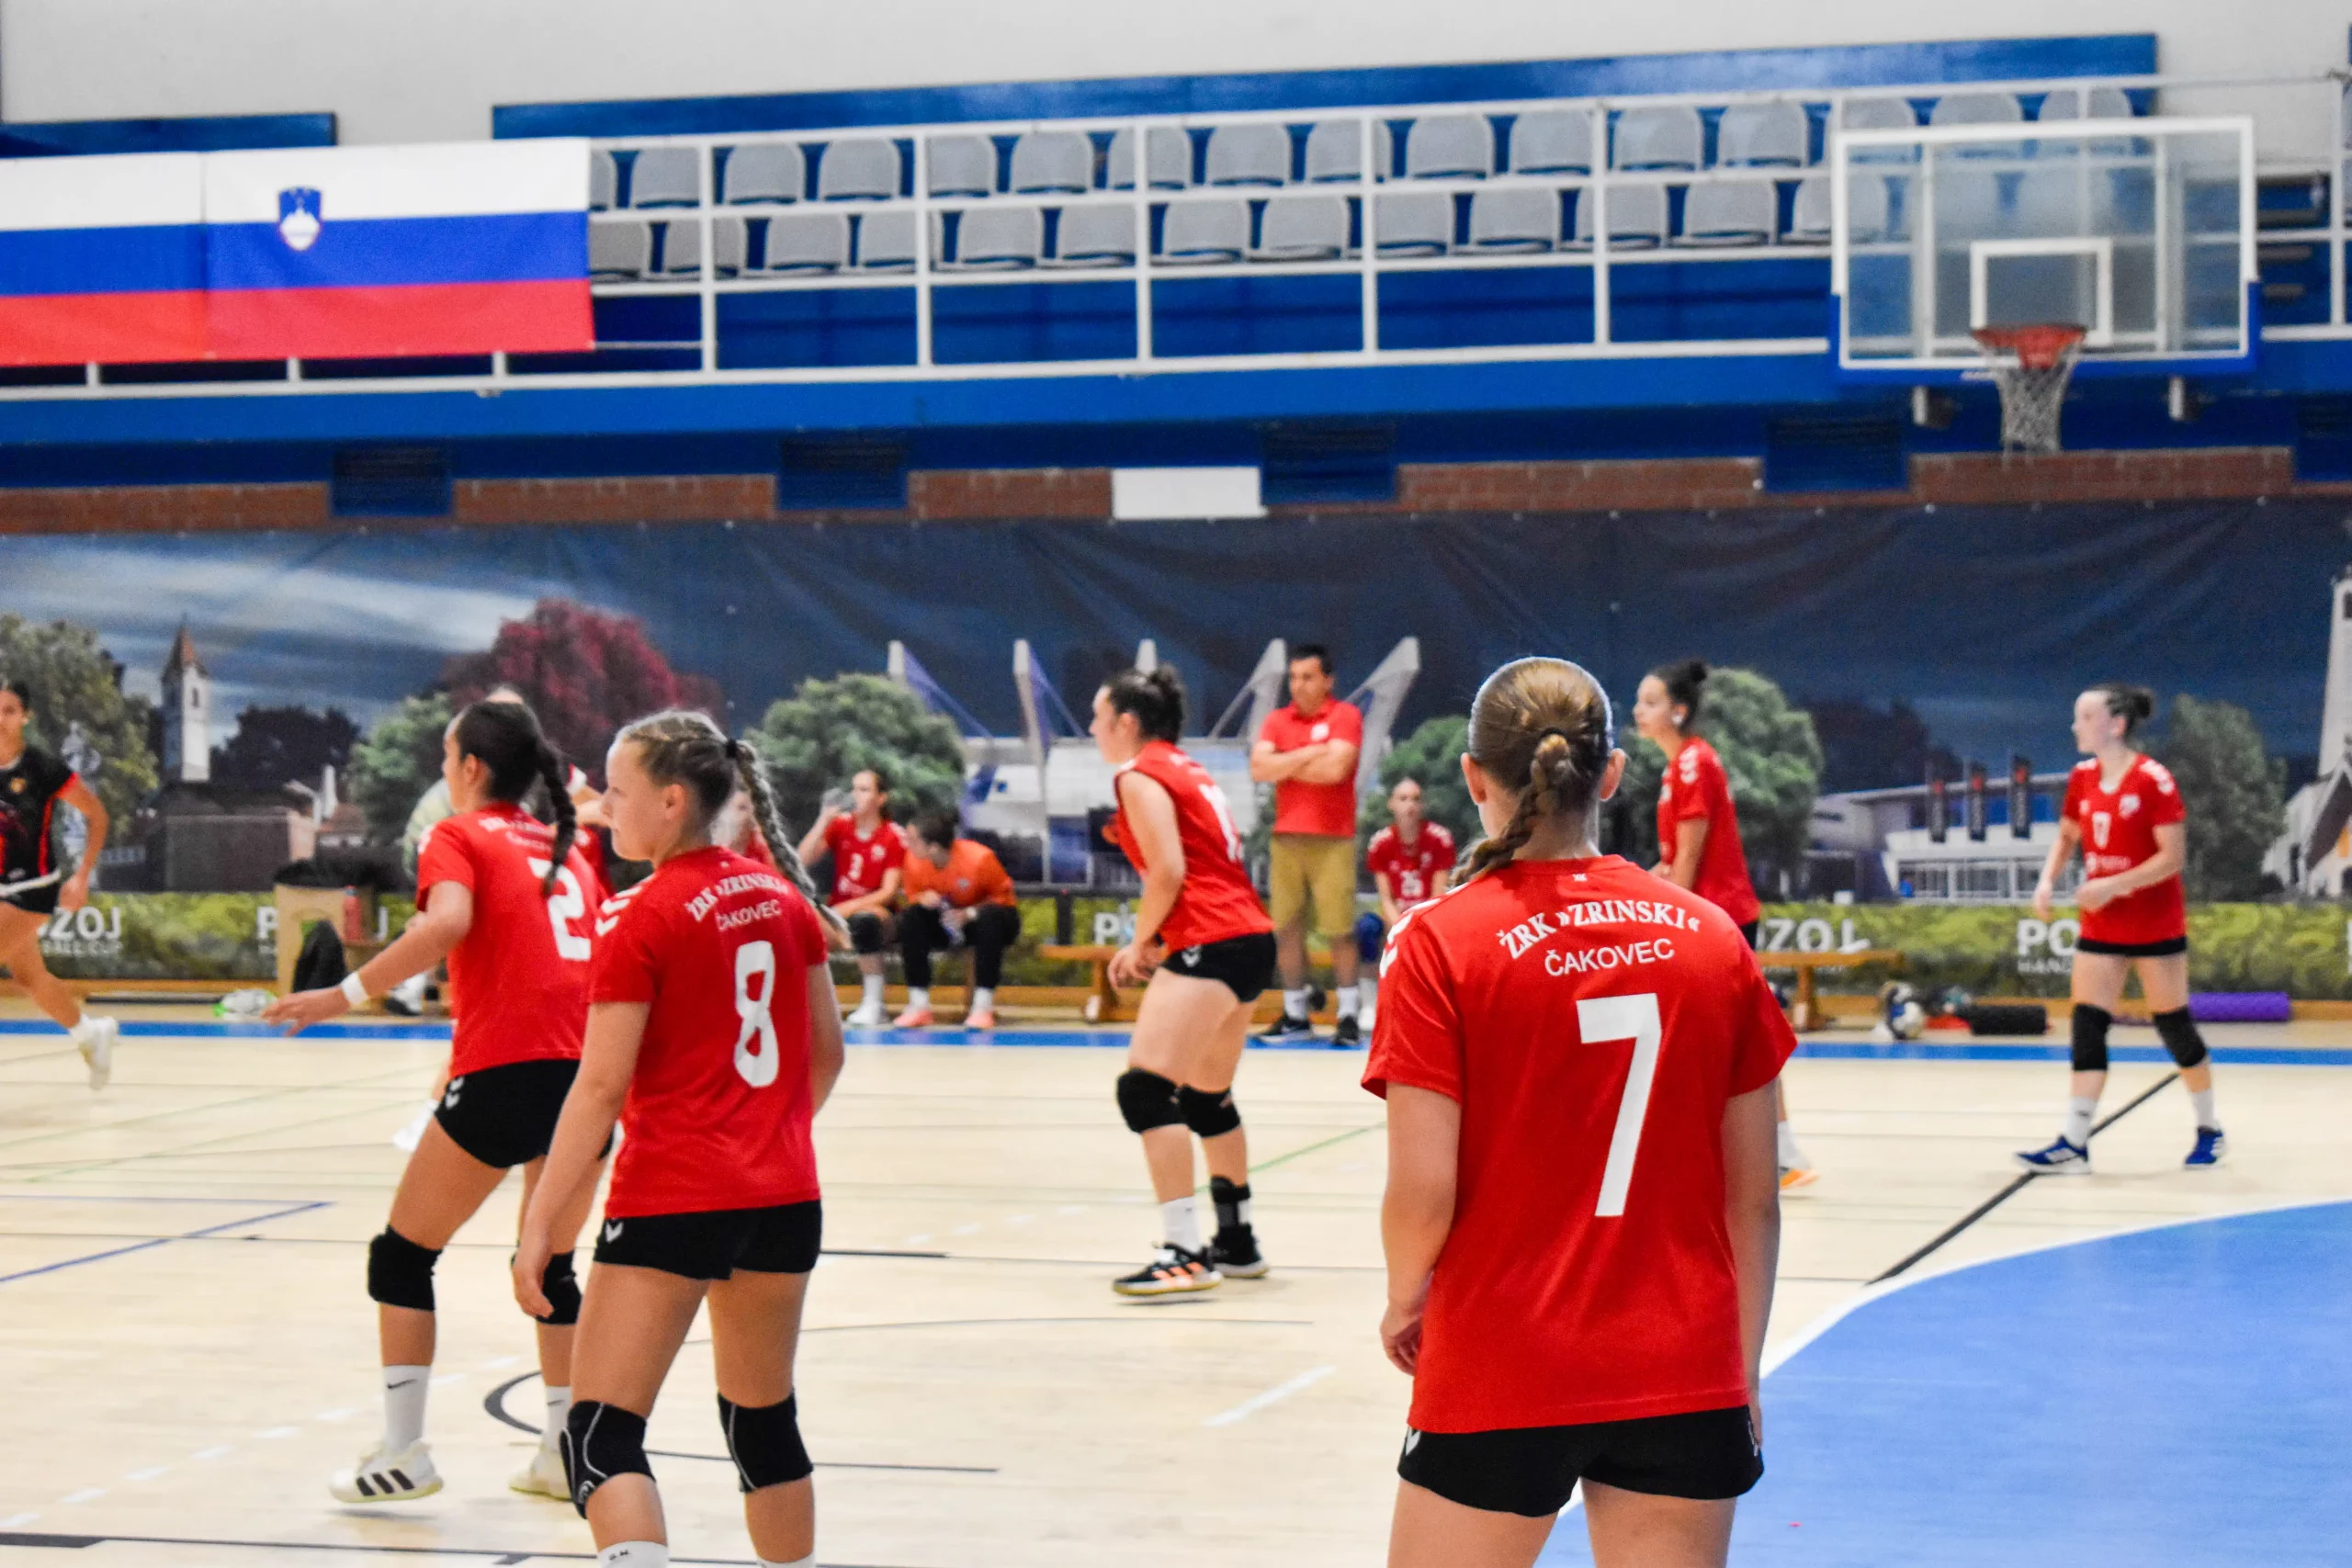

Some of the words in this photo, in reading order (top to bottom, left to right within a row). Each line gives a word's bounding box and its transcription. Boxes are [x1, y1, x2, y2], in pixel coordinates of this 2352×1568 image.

[38, 906, 121, 939] ZOJ
[526, 856, 592, 962] 2
[1497, 912, 1556, 959] ŽRK
[1756, 918, 1855, 954] ZOJ
[2018, 919, 2081, 956] PO
[1544, 938, 1675, 976] ČAKOVEC
[734, 940, 779, 1088] 8
[1577, 993, 1662, 1217] 7
